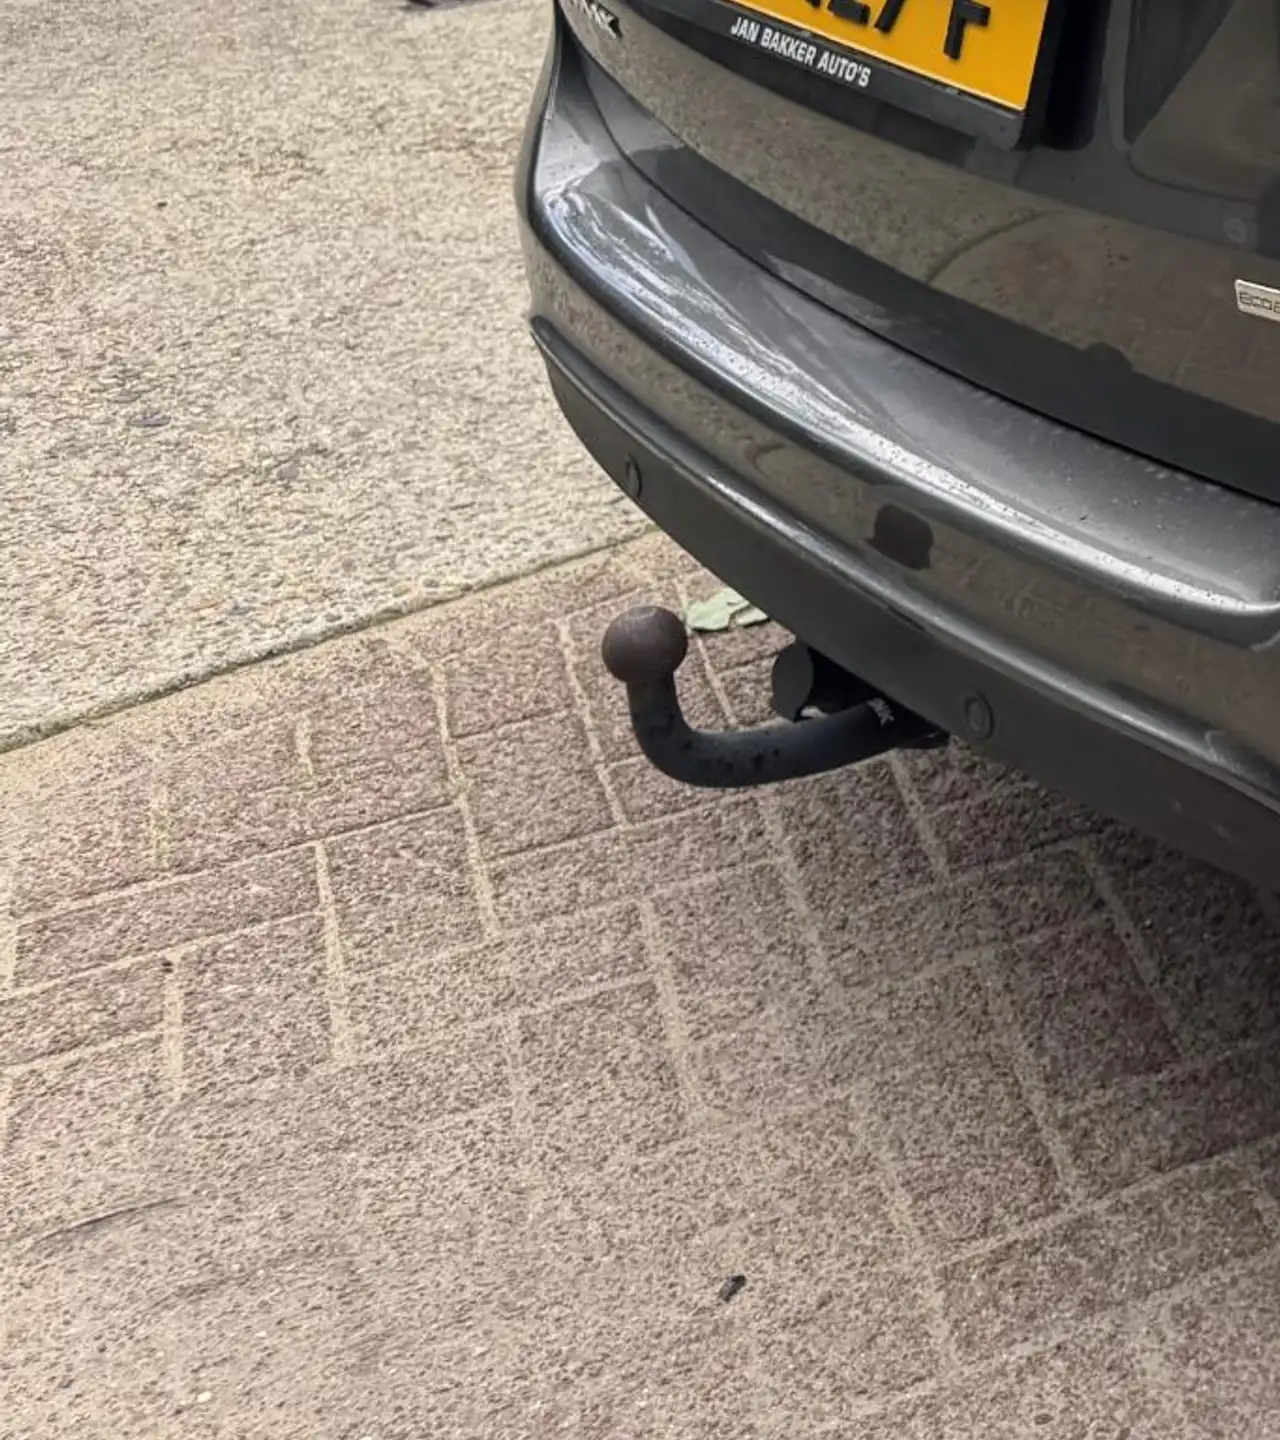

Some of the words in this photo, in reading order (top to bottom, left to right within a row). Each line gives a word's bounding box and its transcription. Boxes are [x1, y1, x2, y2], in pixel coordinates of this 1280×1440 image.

[730, 16, 761, 43] JAN
[760, 27, 818, 67] BAKKER
[817, 50, 872, 88] AUTO'S
